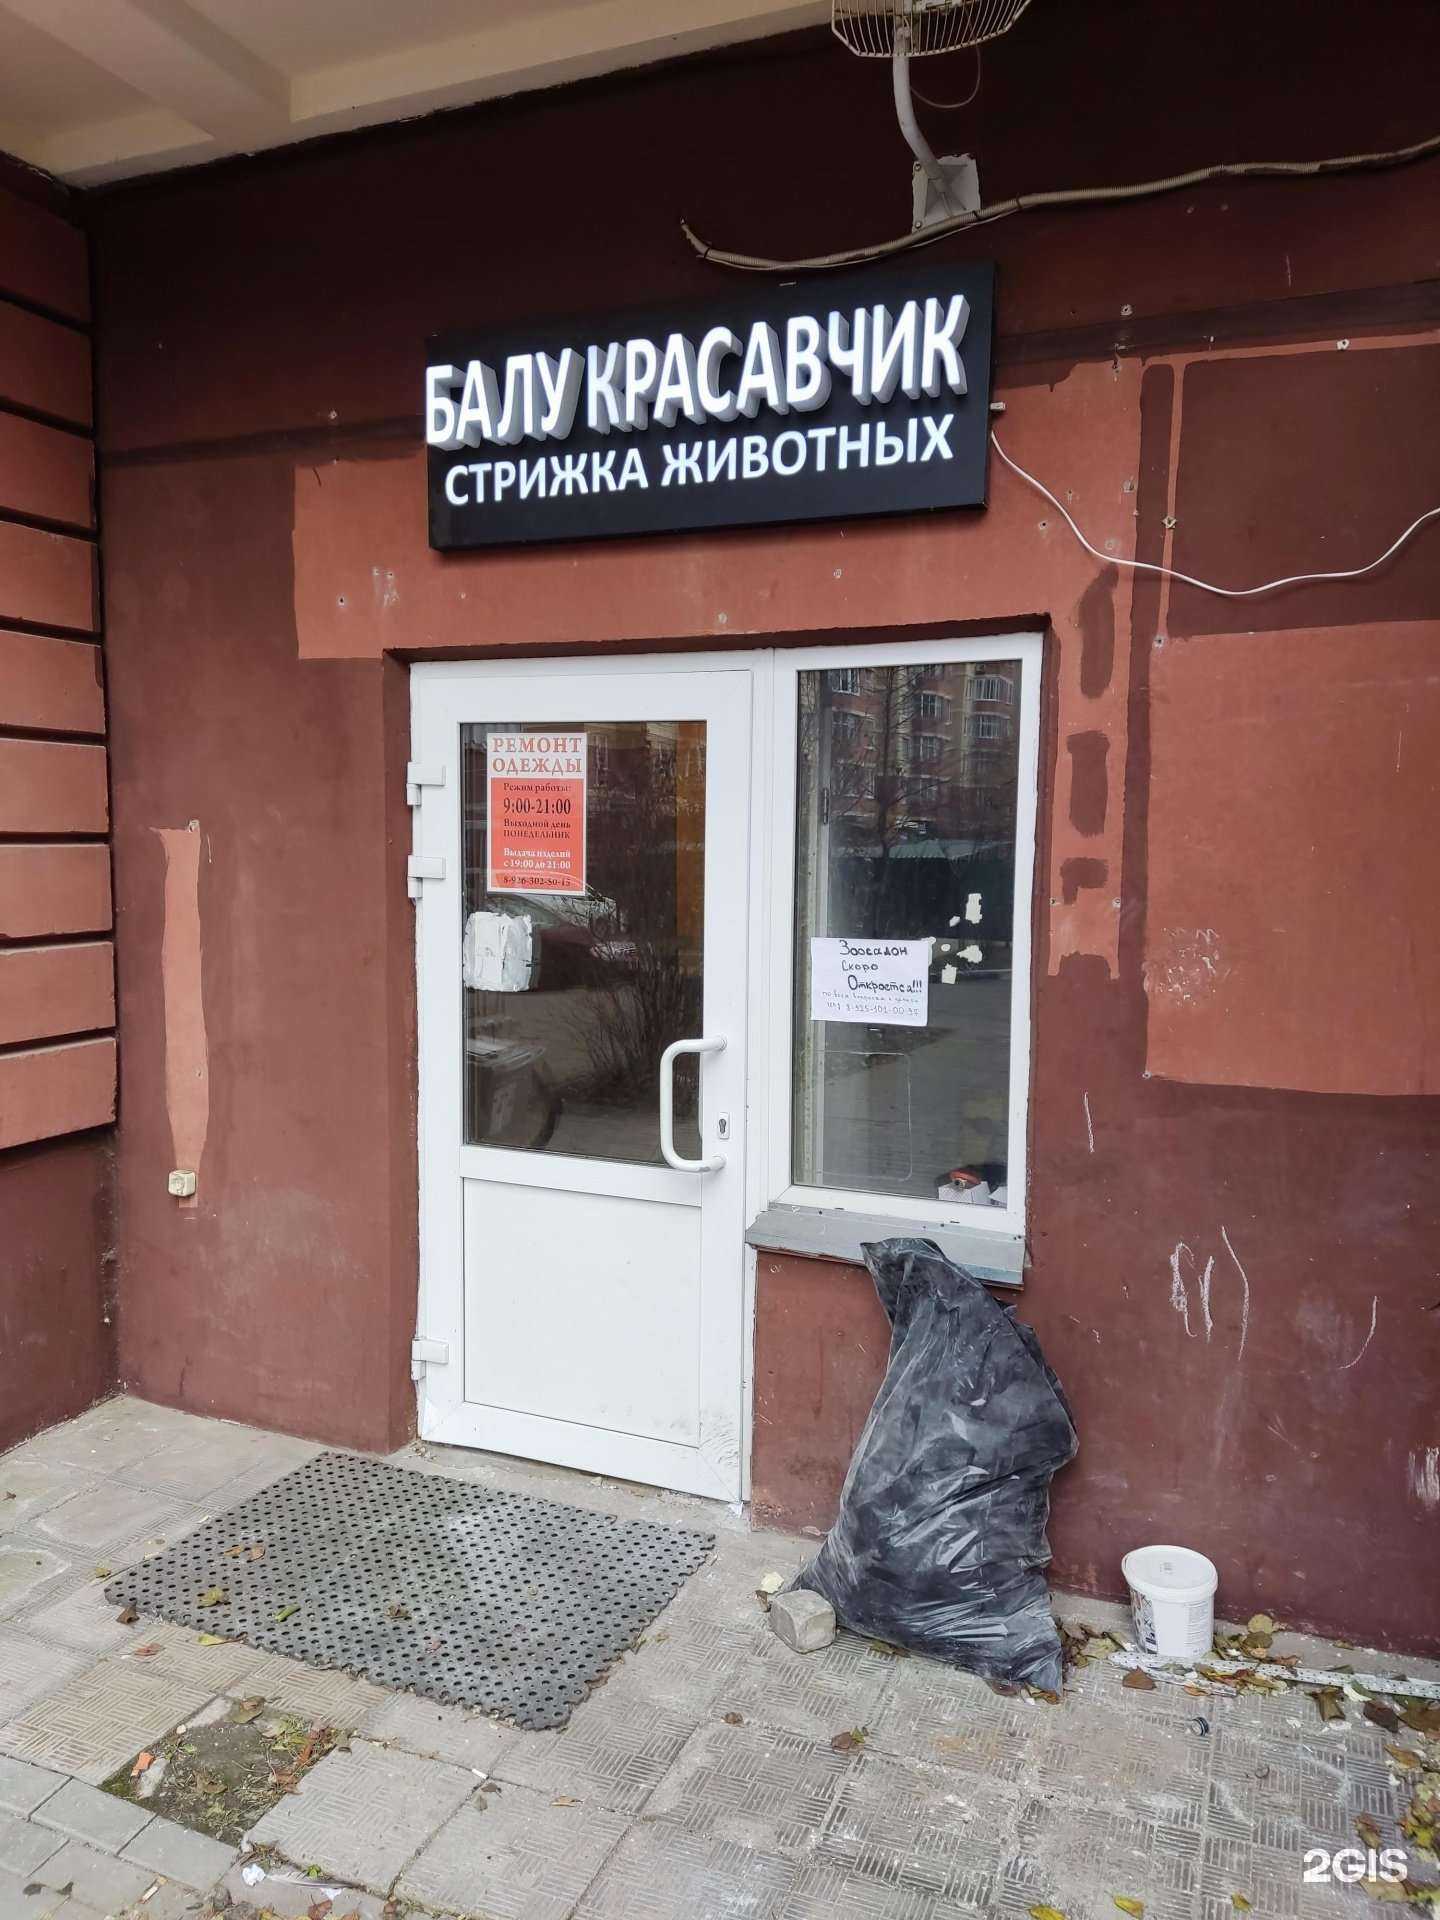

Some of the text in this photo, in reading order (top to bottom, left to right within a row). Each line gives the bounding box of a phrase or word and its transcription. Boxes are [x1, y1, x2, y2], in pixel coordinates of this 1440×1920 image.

[425, 294, 970, 452] БАЛУ КРАСАВЧИК
[444, 413, 955, 505] СТРИЖКА ЖИВОТНЫХ
[493, 737, 582, 753] РЕМОНТ
[493, 757, 582, 776] ОДЕЖДЫ
[503, 782, 533, 792] Режим
[503, 798, 571, 815] 9:00-21:00
[503, 818, 571, 830] Выходной день
[503, 830, 570, 840] ПОНЕДЕЛЬНИК
[504, 847, 571, 859] Выдача изделий
[510, 859, 534, 869] 19:00
[546, 861, 571, 870] 21:00
[839, 939, 908, 957] Зоосалон
[841, 959, 879, 973] Скоро
